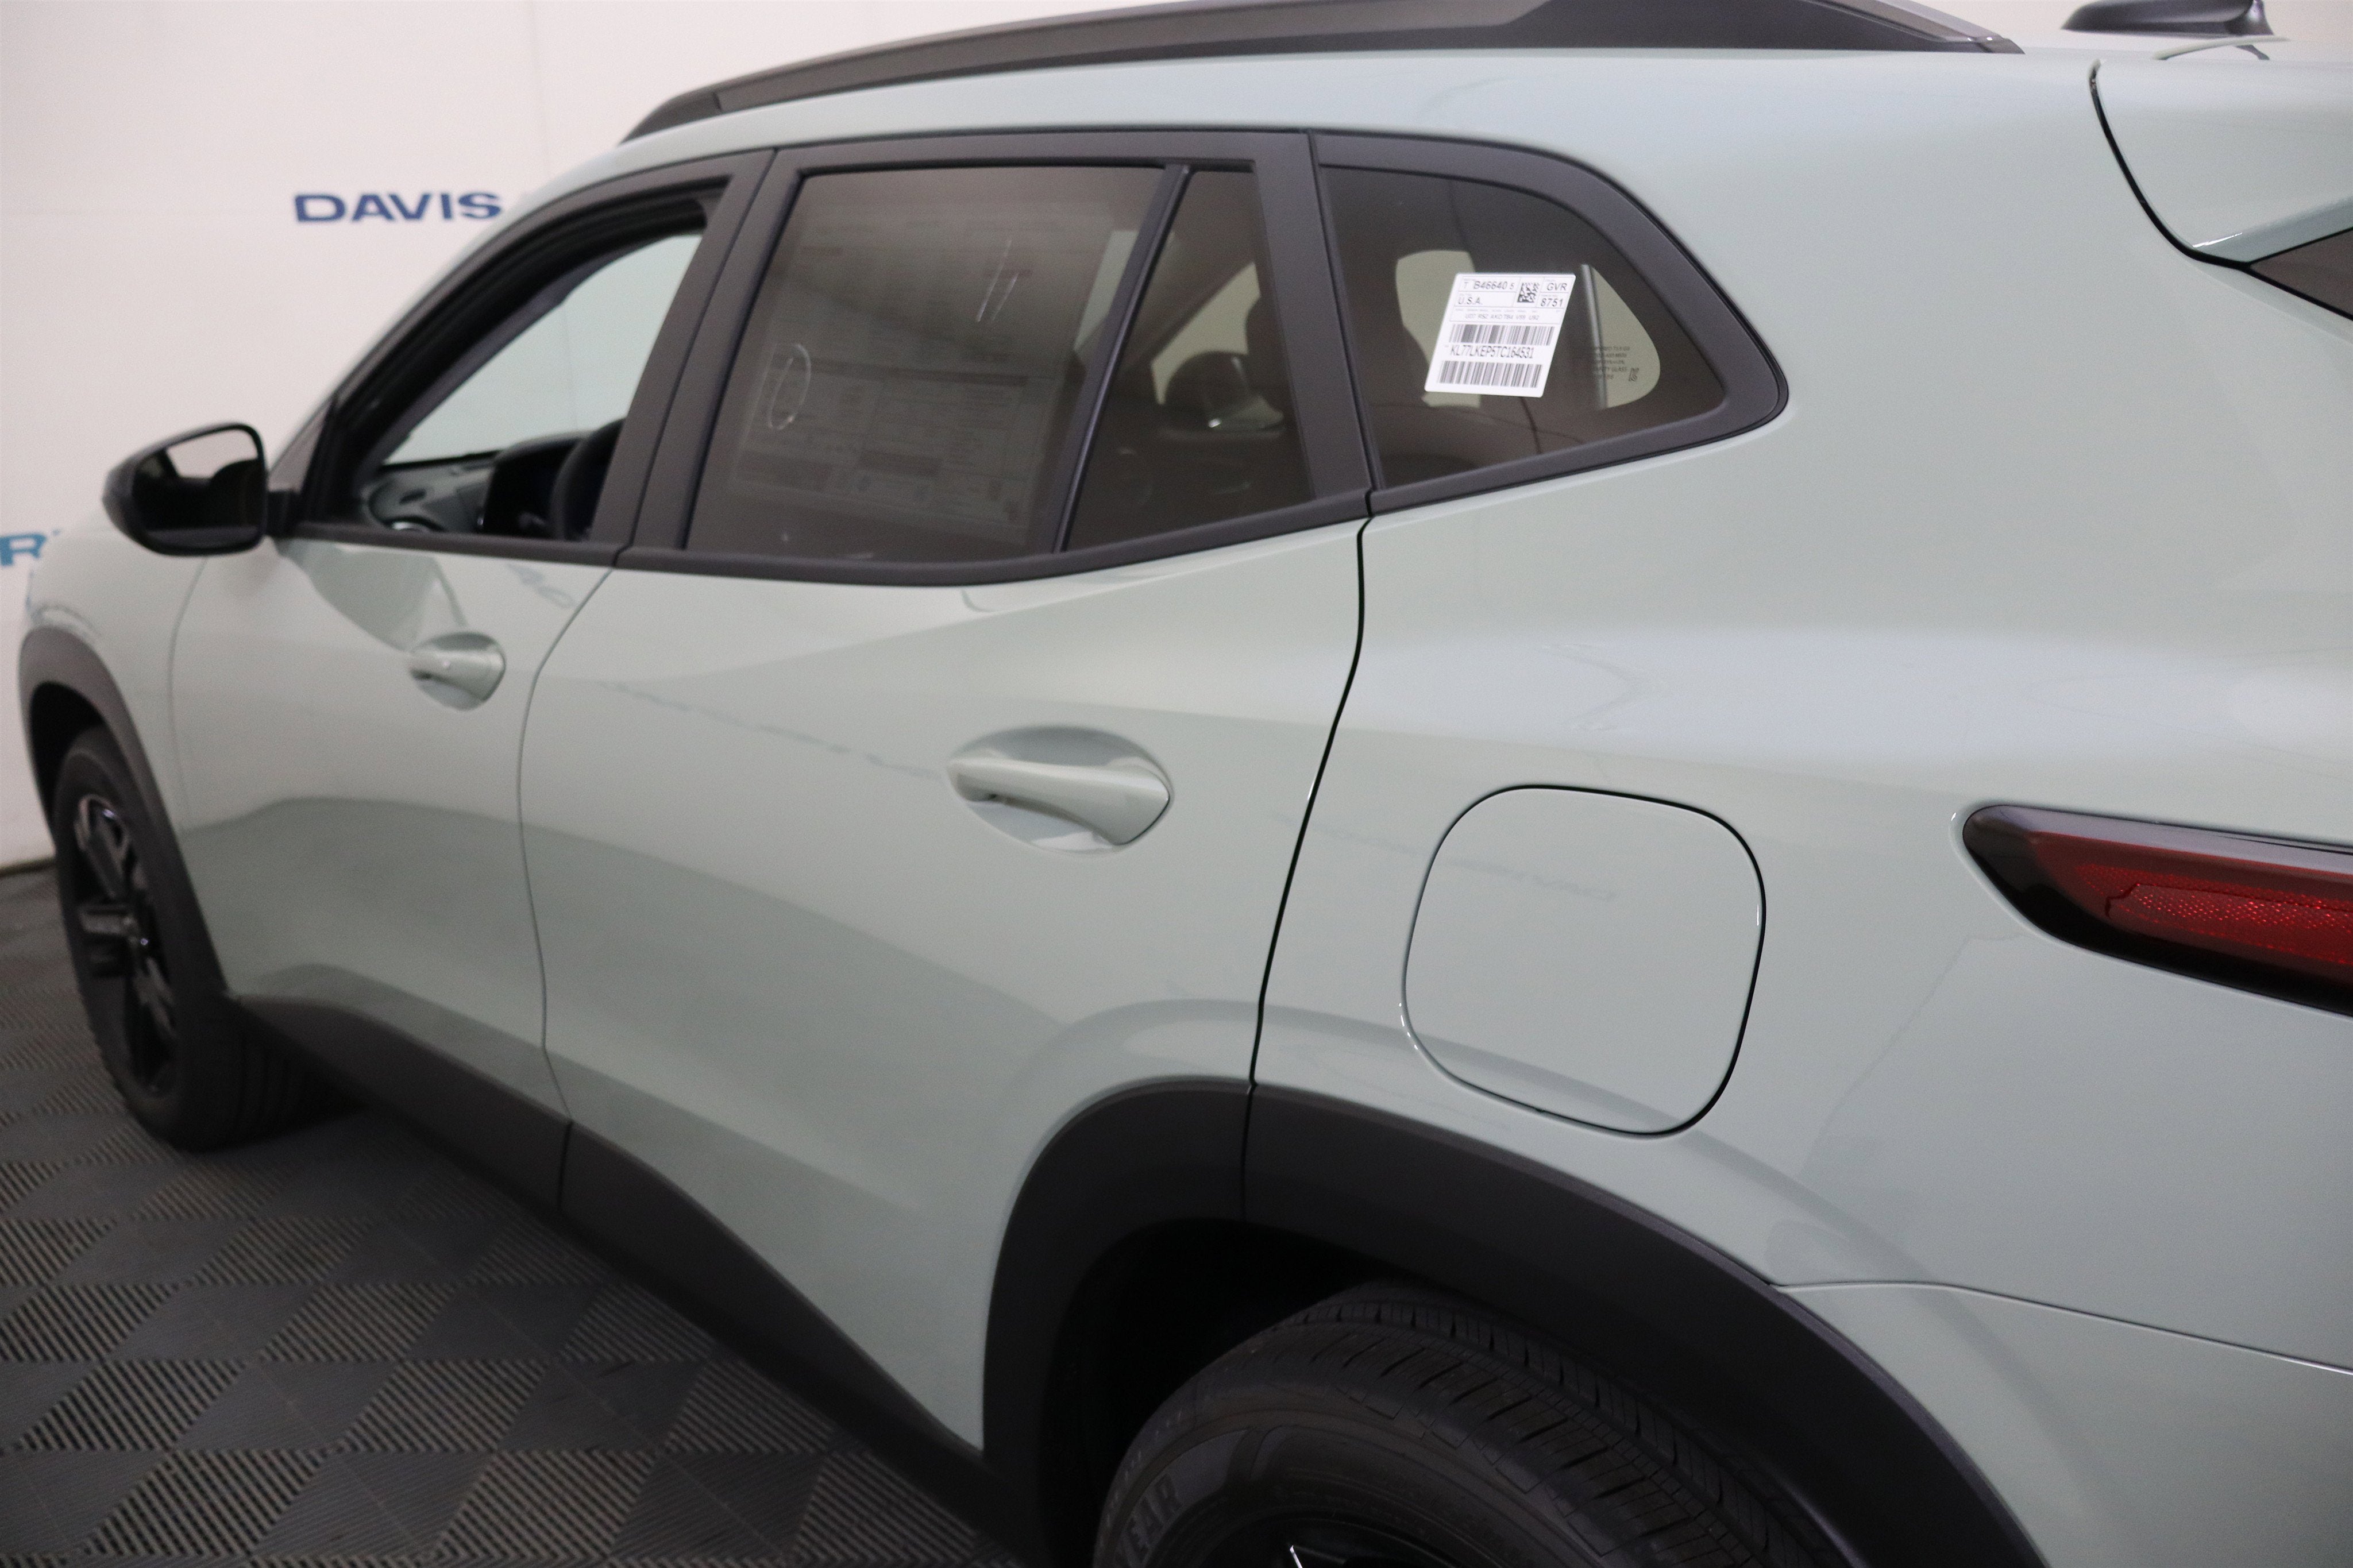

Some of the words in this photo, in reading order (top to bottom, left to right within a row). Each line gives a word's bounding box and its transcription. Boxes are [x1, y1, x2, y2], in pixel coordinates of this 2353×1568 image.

[295, 192, 502, 222] DAVIS
[1546, 282, 1568, 291] GVR
[1458, 296, 1482, 305] U.S.A.
[1540, 298, 1563, 307] 8751
[1451, 345, 1535, 358] KL77LKEP5TC164531
